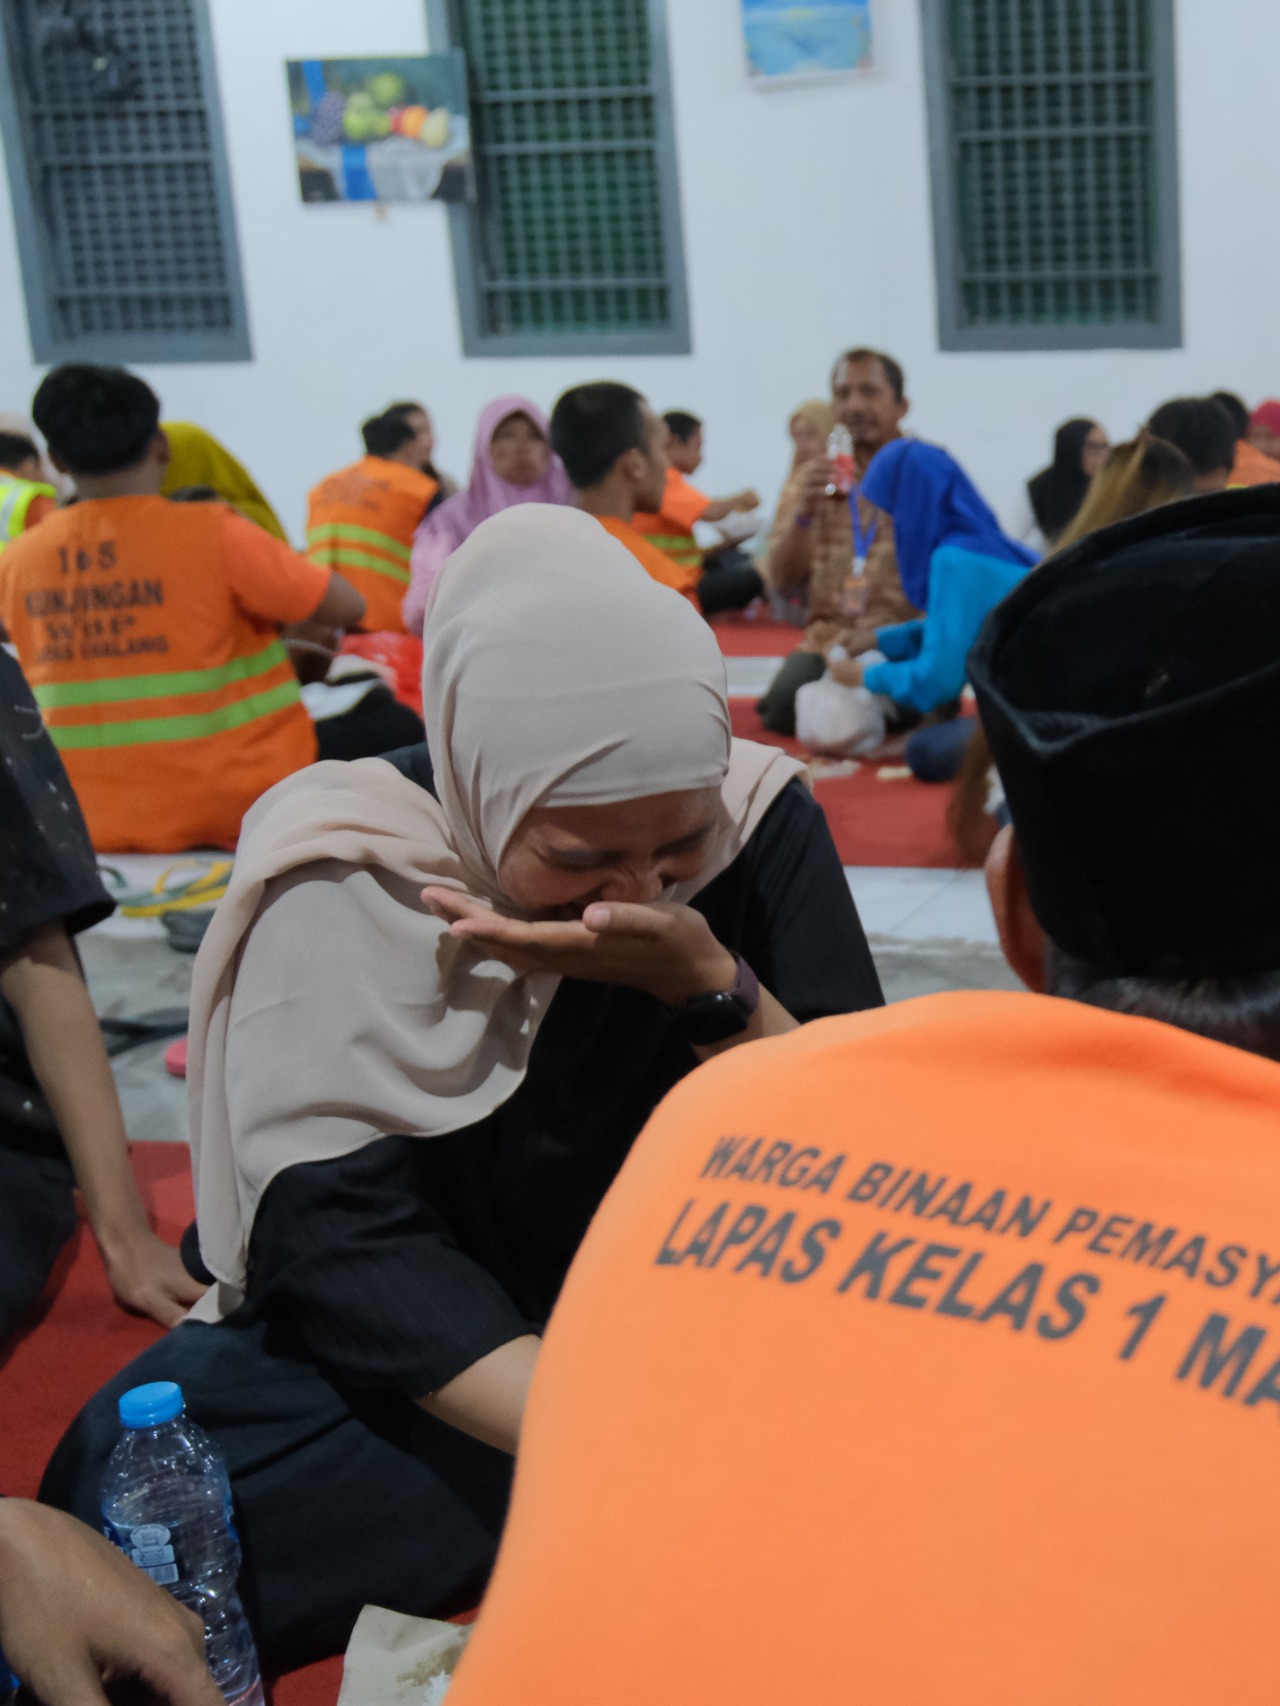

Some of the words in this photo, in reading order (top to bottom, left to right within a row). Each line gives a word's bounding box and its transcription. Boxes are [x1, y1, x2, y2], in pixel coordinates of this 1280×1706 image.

[701, 1138, 842, 1195] WARGA
[847, 1162, 1052, 1239] BINAAN
[654, 1200, 843, 1285] LAPAS
[836, 1231, 1101, 1342] KELAS
[1119, 1294, 1167, 1361] 1
